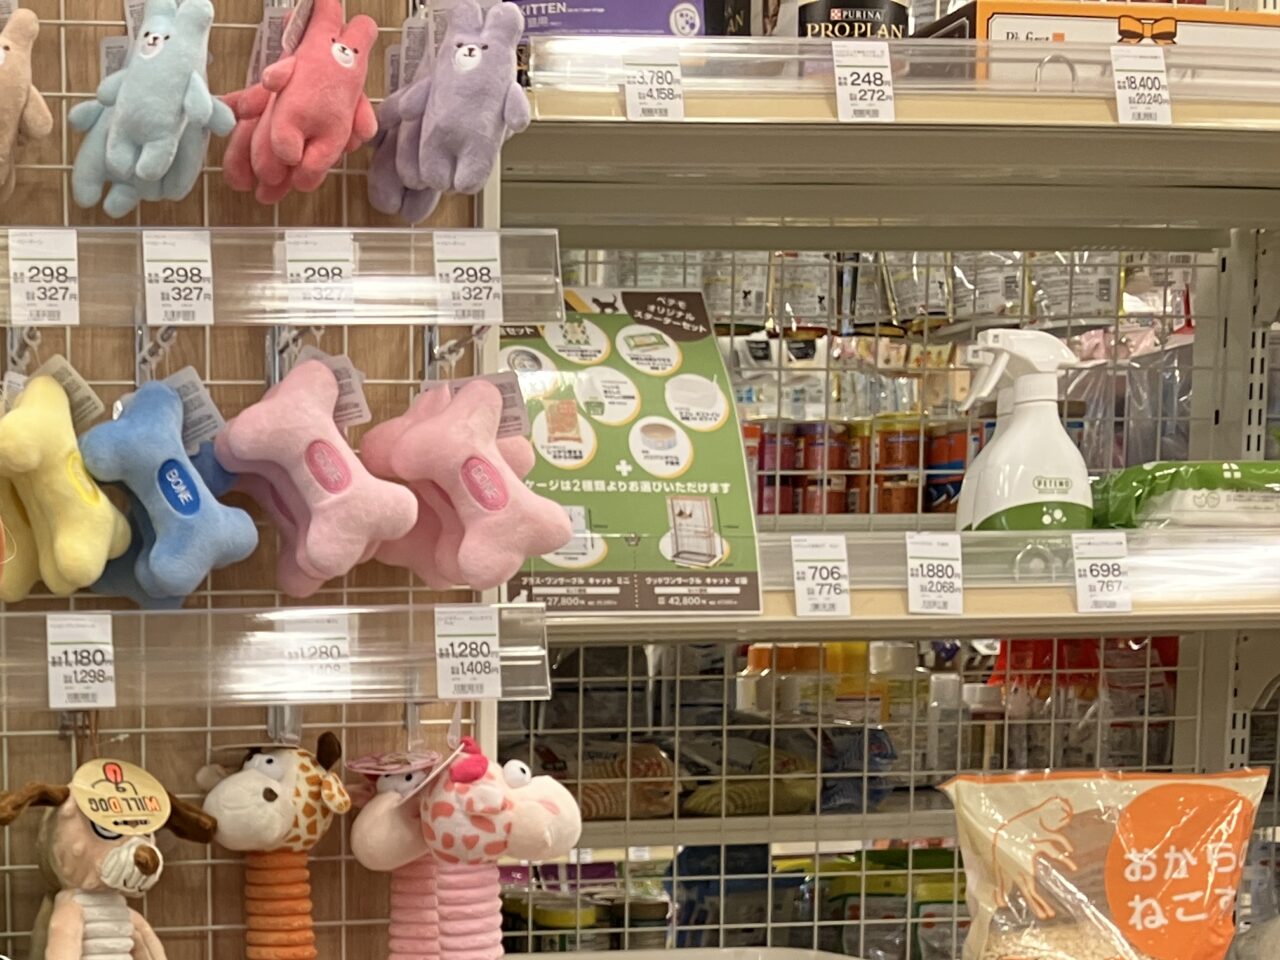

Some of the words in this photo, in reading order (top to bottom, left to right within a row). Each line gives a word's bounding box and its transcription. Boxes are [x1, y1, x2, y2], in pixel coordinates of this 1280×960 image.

[842, 10, 883, 19] PURINA
[165, 468, 193, 506] BONE
[88, 796, 122, 813] DOG
[120, 796, 161, 812] WILL
